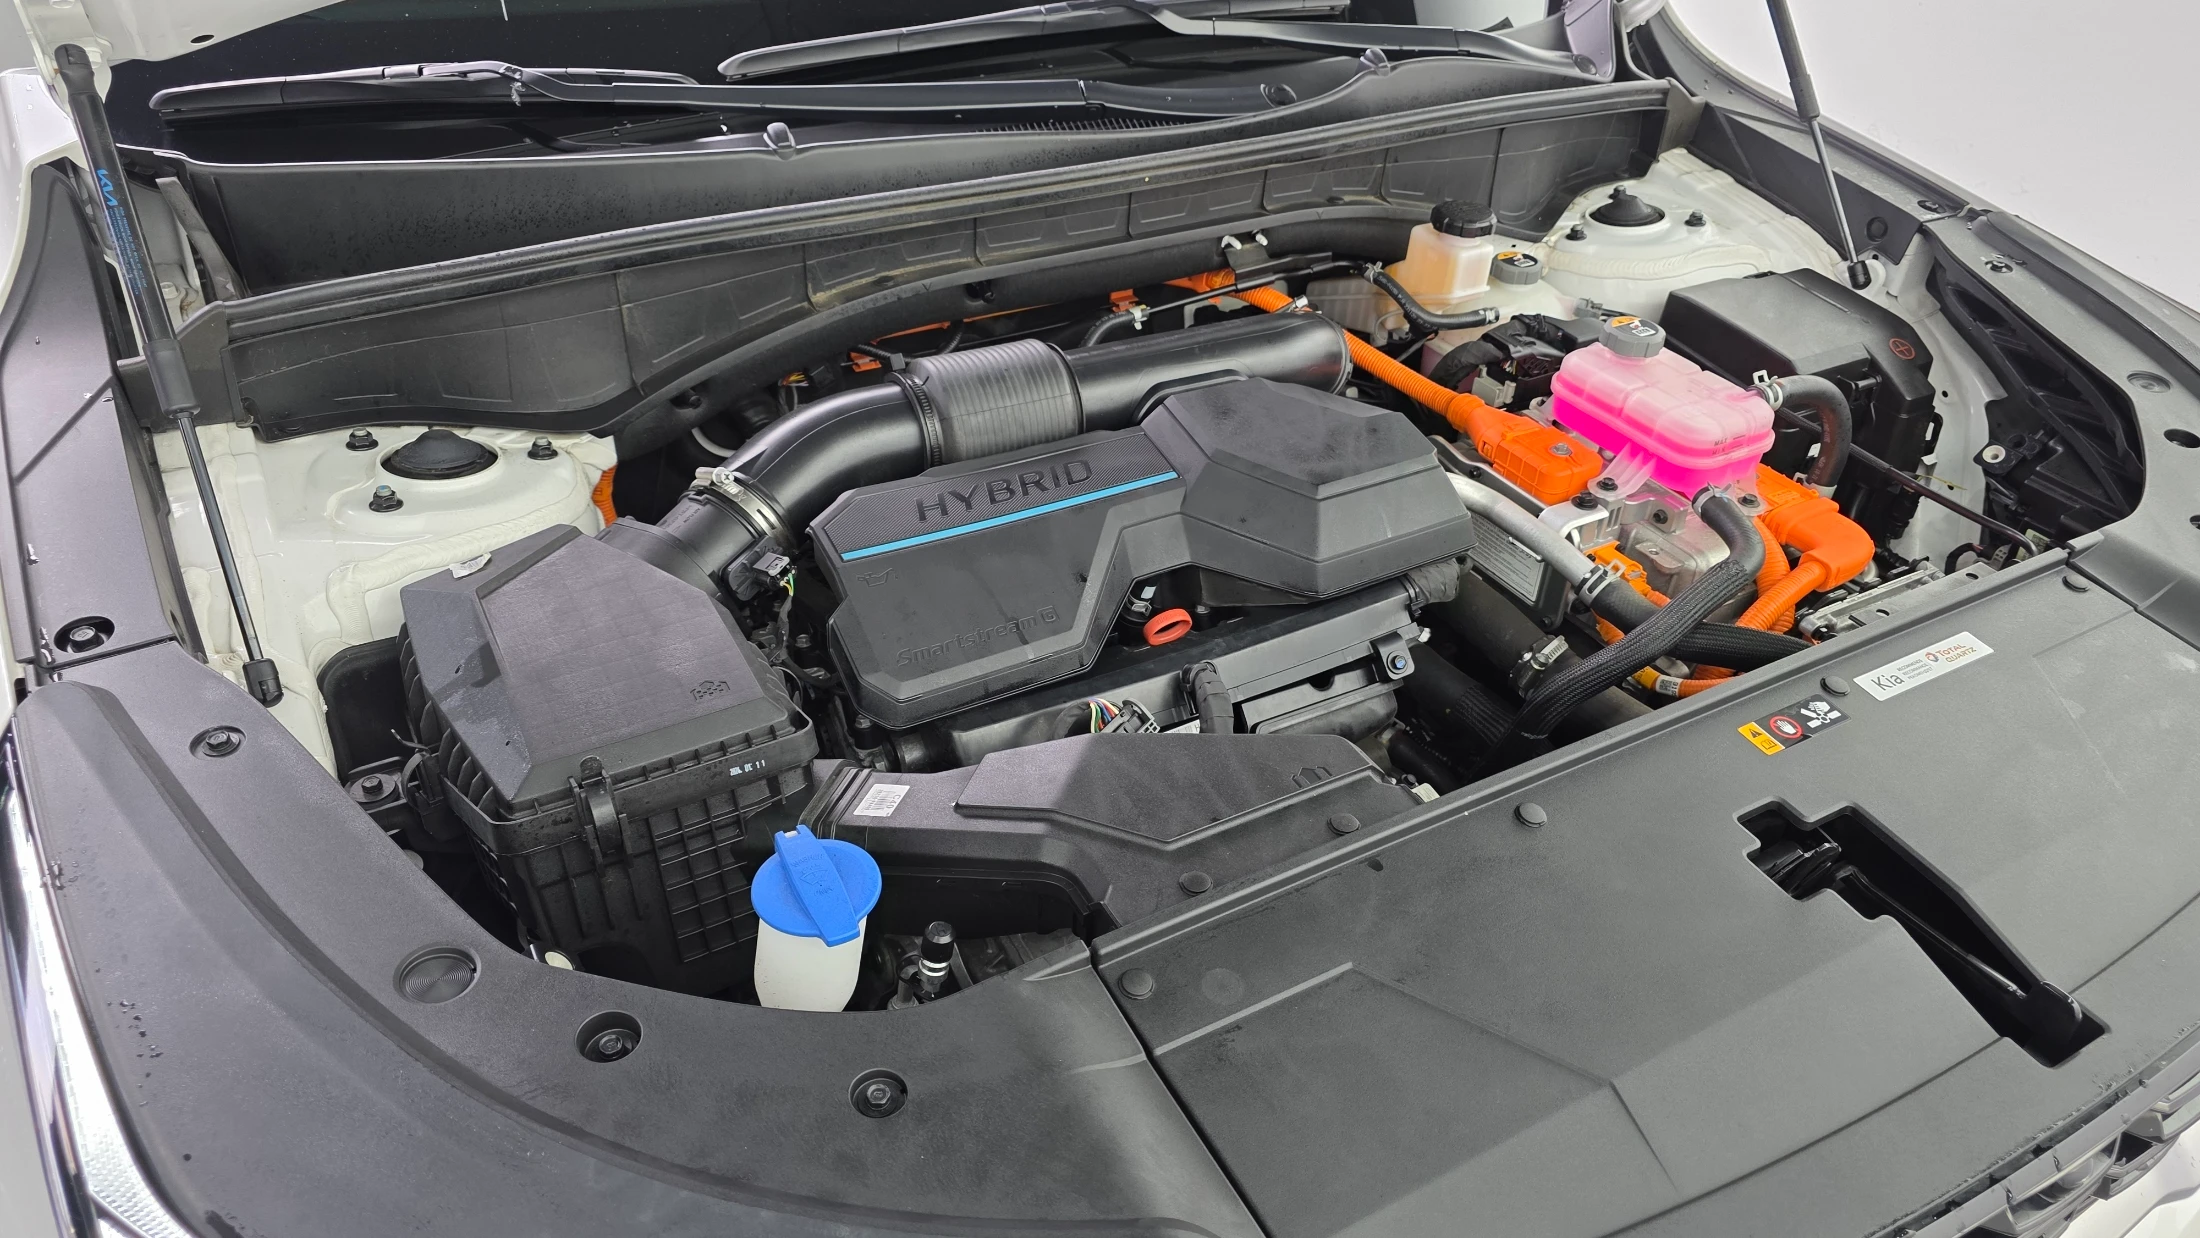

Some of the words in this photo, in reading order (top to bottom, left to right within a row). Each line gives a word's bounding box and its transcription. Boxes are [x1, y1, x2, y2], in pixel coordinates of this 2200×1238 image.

[916, 459, 1093, 522] HYBRID
[896, 614, 1037, 667] Smartstream
[1037, 604, 1060, 623] G
[1935, 643, 1967, 657] TOTAL
[1945, 647, 1977, 663] QUARTZ
[1871, 673, 1905, 691] Kia
